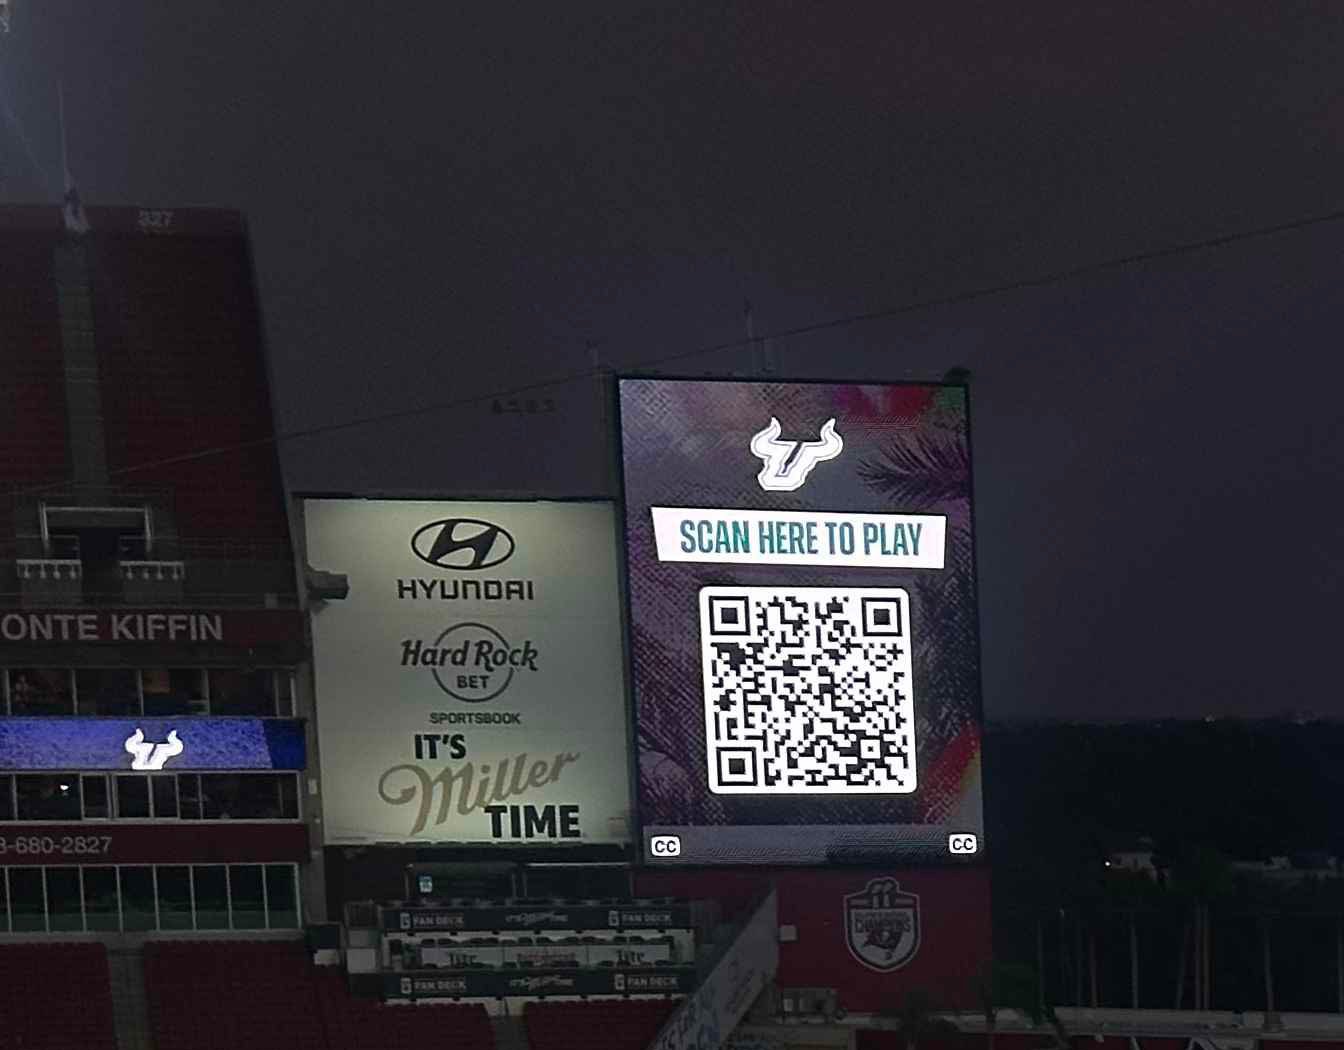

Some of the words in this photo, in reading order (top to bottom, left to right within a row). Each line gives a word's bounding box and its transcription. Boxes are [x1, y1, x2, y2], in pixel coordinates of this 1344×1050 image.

[680, 518, 750, 554] SCAN
[758, 521, 818, 554] HERE
[825, 522, 856, 555] TO
[864, 522, 923, 556] PLAY
[398, 577, 534, 601] HYUNDAI
[0, 613, 100, 641] ONTE
[111, 613, 224, 641] KIFFIN
[400, 638, 469, 671] Hard
[474, 638, 539, 671] Rock
[456, 674, 489, 690] BET
[429, 712, 521, 725] SPORTSBOOK
[414, 734, 467, 760] IT'S
[378, 751, 581, 836] Miller
[484, 804, 580, 839] TIME
[654, 840, 678, 854] CC
[952, 838, 975, 852] CC
